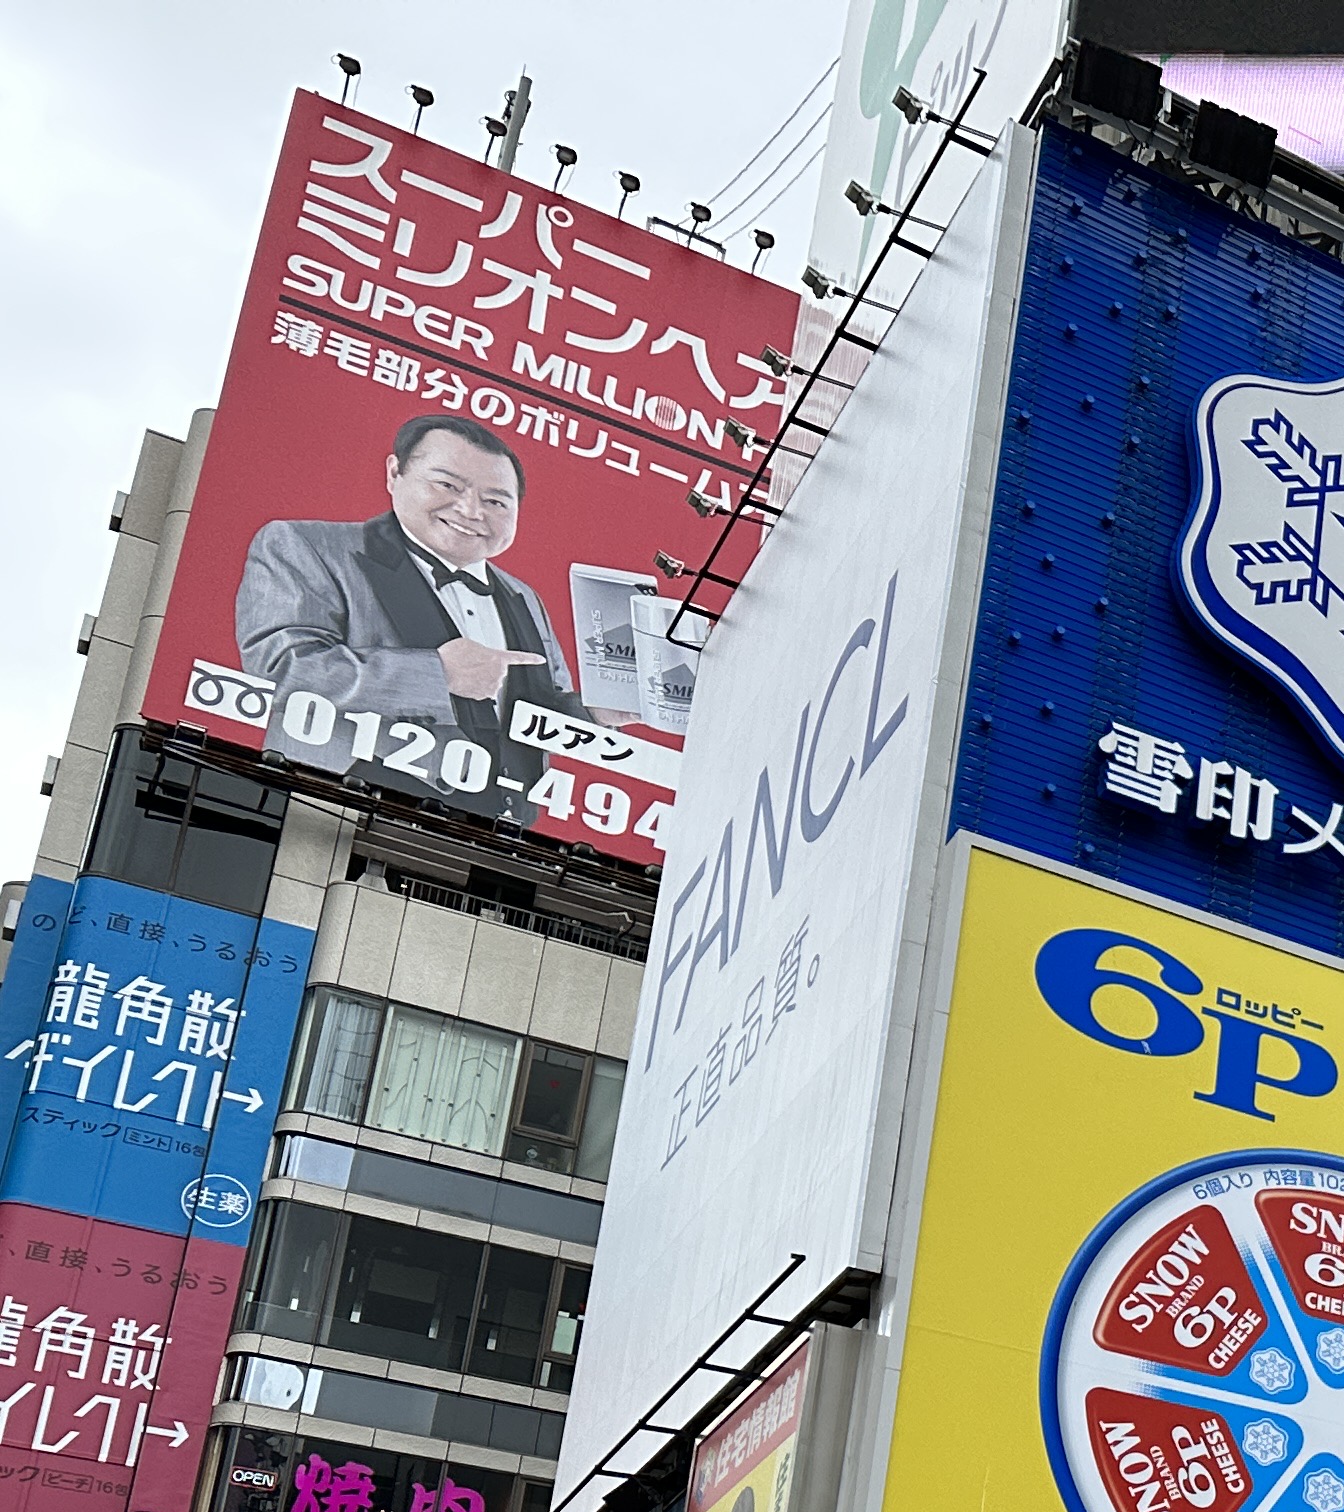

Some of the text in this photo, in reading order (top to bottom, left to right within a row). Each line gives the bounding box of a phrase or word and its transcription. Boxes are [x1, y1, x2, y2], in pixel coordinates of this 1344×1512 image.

[309, 116, 651, 280] スーパー
[282, 255, 727, 450] SUPER MILLION
[521, 713, 634, 762] ルアン
[645, 569, 910, 1075] FANCL
[32, 904, 298, 975] のど、直接、うるおう
[46, 958, 247, 1062] 龍角散
[1216, 986, 1325, 1032] ロッピー
[4, 1032, 224, 1132] ダイレクト
[23, 1105, 122, 1138] スティック
[127, 1131, 171, 1151] ミント
[187, 1187, 248, 1217] 生薬
[1193, 1170, 1254, 1202] 6個入り
[1117, 1223, 1212, 1334] SNOW
[1167, 1273, 1207, 1320] BRAND
[1172, 1284, 1241, 1350] 6P
[1206, 1308, 1263, 1371] CHEESE
[714, 1369, 802, 1488] 住宅情報館
[1202, 1417, 1247, 1494] CHEESE
[46, 1472, 93, 1491] ピーチ
[232, 1470, 276, 1488] OPEN
[1148, 1445, 1183, 1501] BRAND
[1170, 1424, 1219, 1510] 6P
